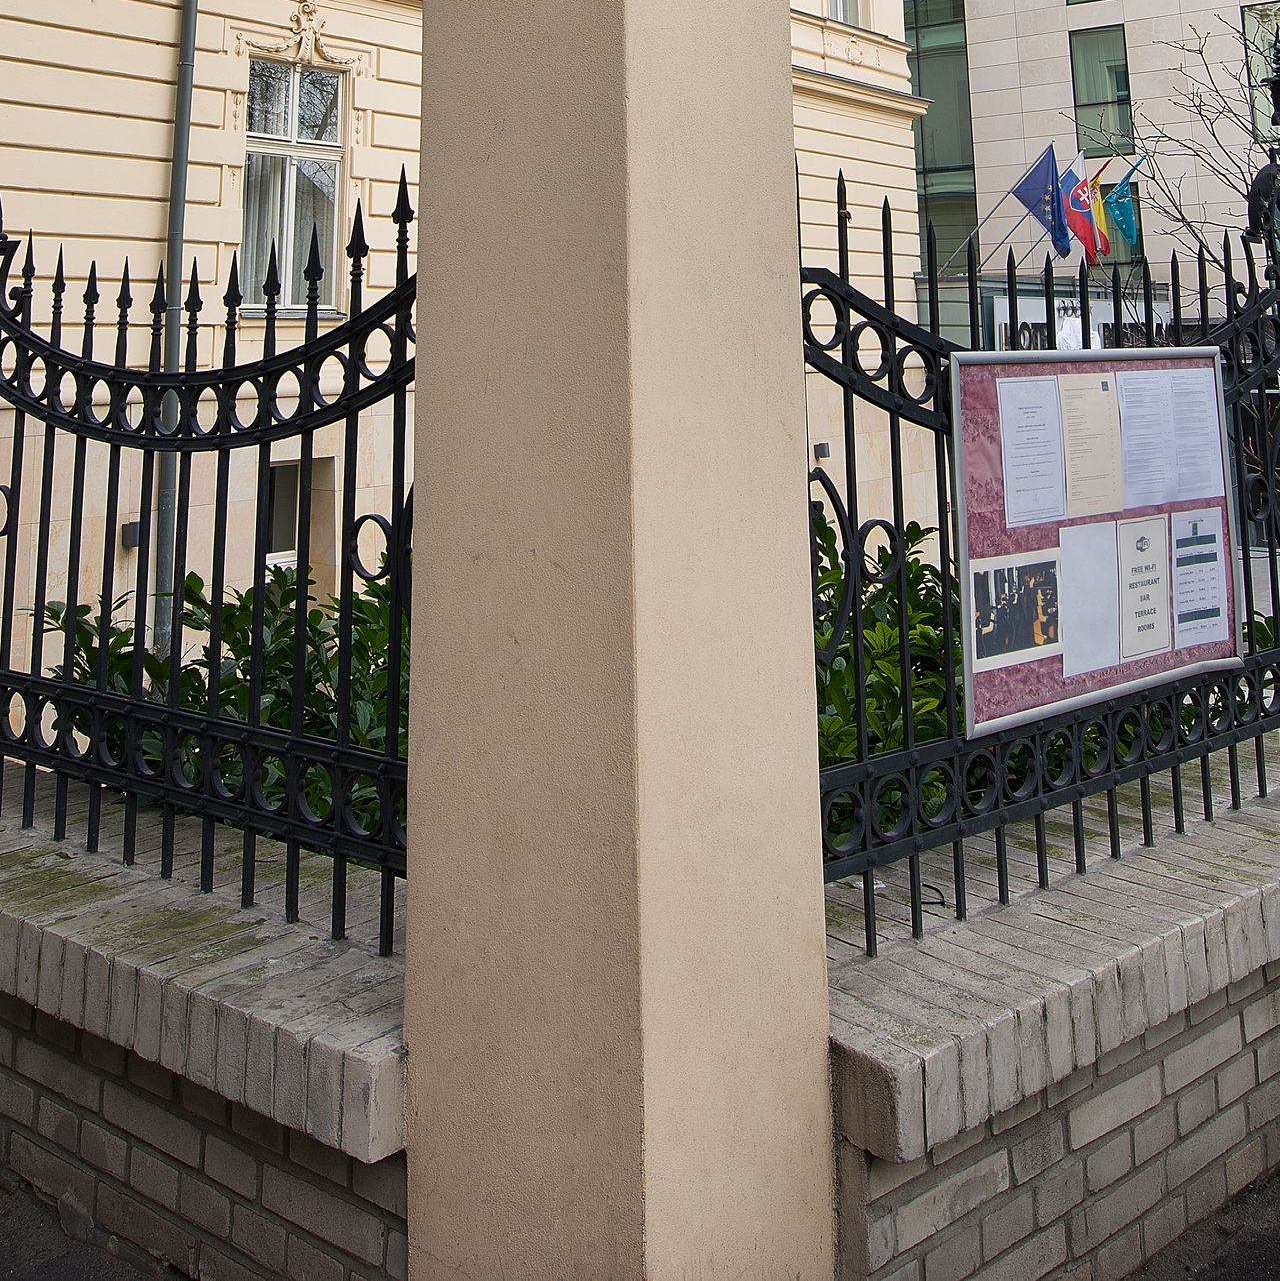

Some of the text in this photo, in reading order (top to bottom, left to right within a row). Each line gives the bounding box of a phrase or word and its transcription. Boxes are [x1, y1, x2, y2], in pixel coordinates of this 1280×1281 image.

[1131, 564, 1157, 574] FREE WI-FI
[1128, 577, 1161, 590] RESTAURANT
[1140, 594, 1150, 602] BAR
[1134, 607, 1157, 619] TERRACE
[1137, 623, 1155, 633] ROOMS
